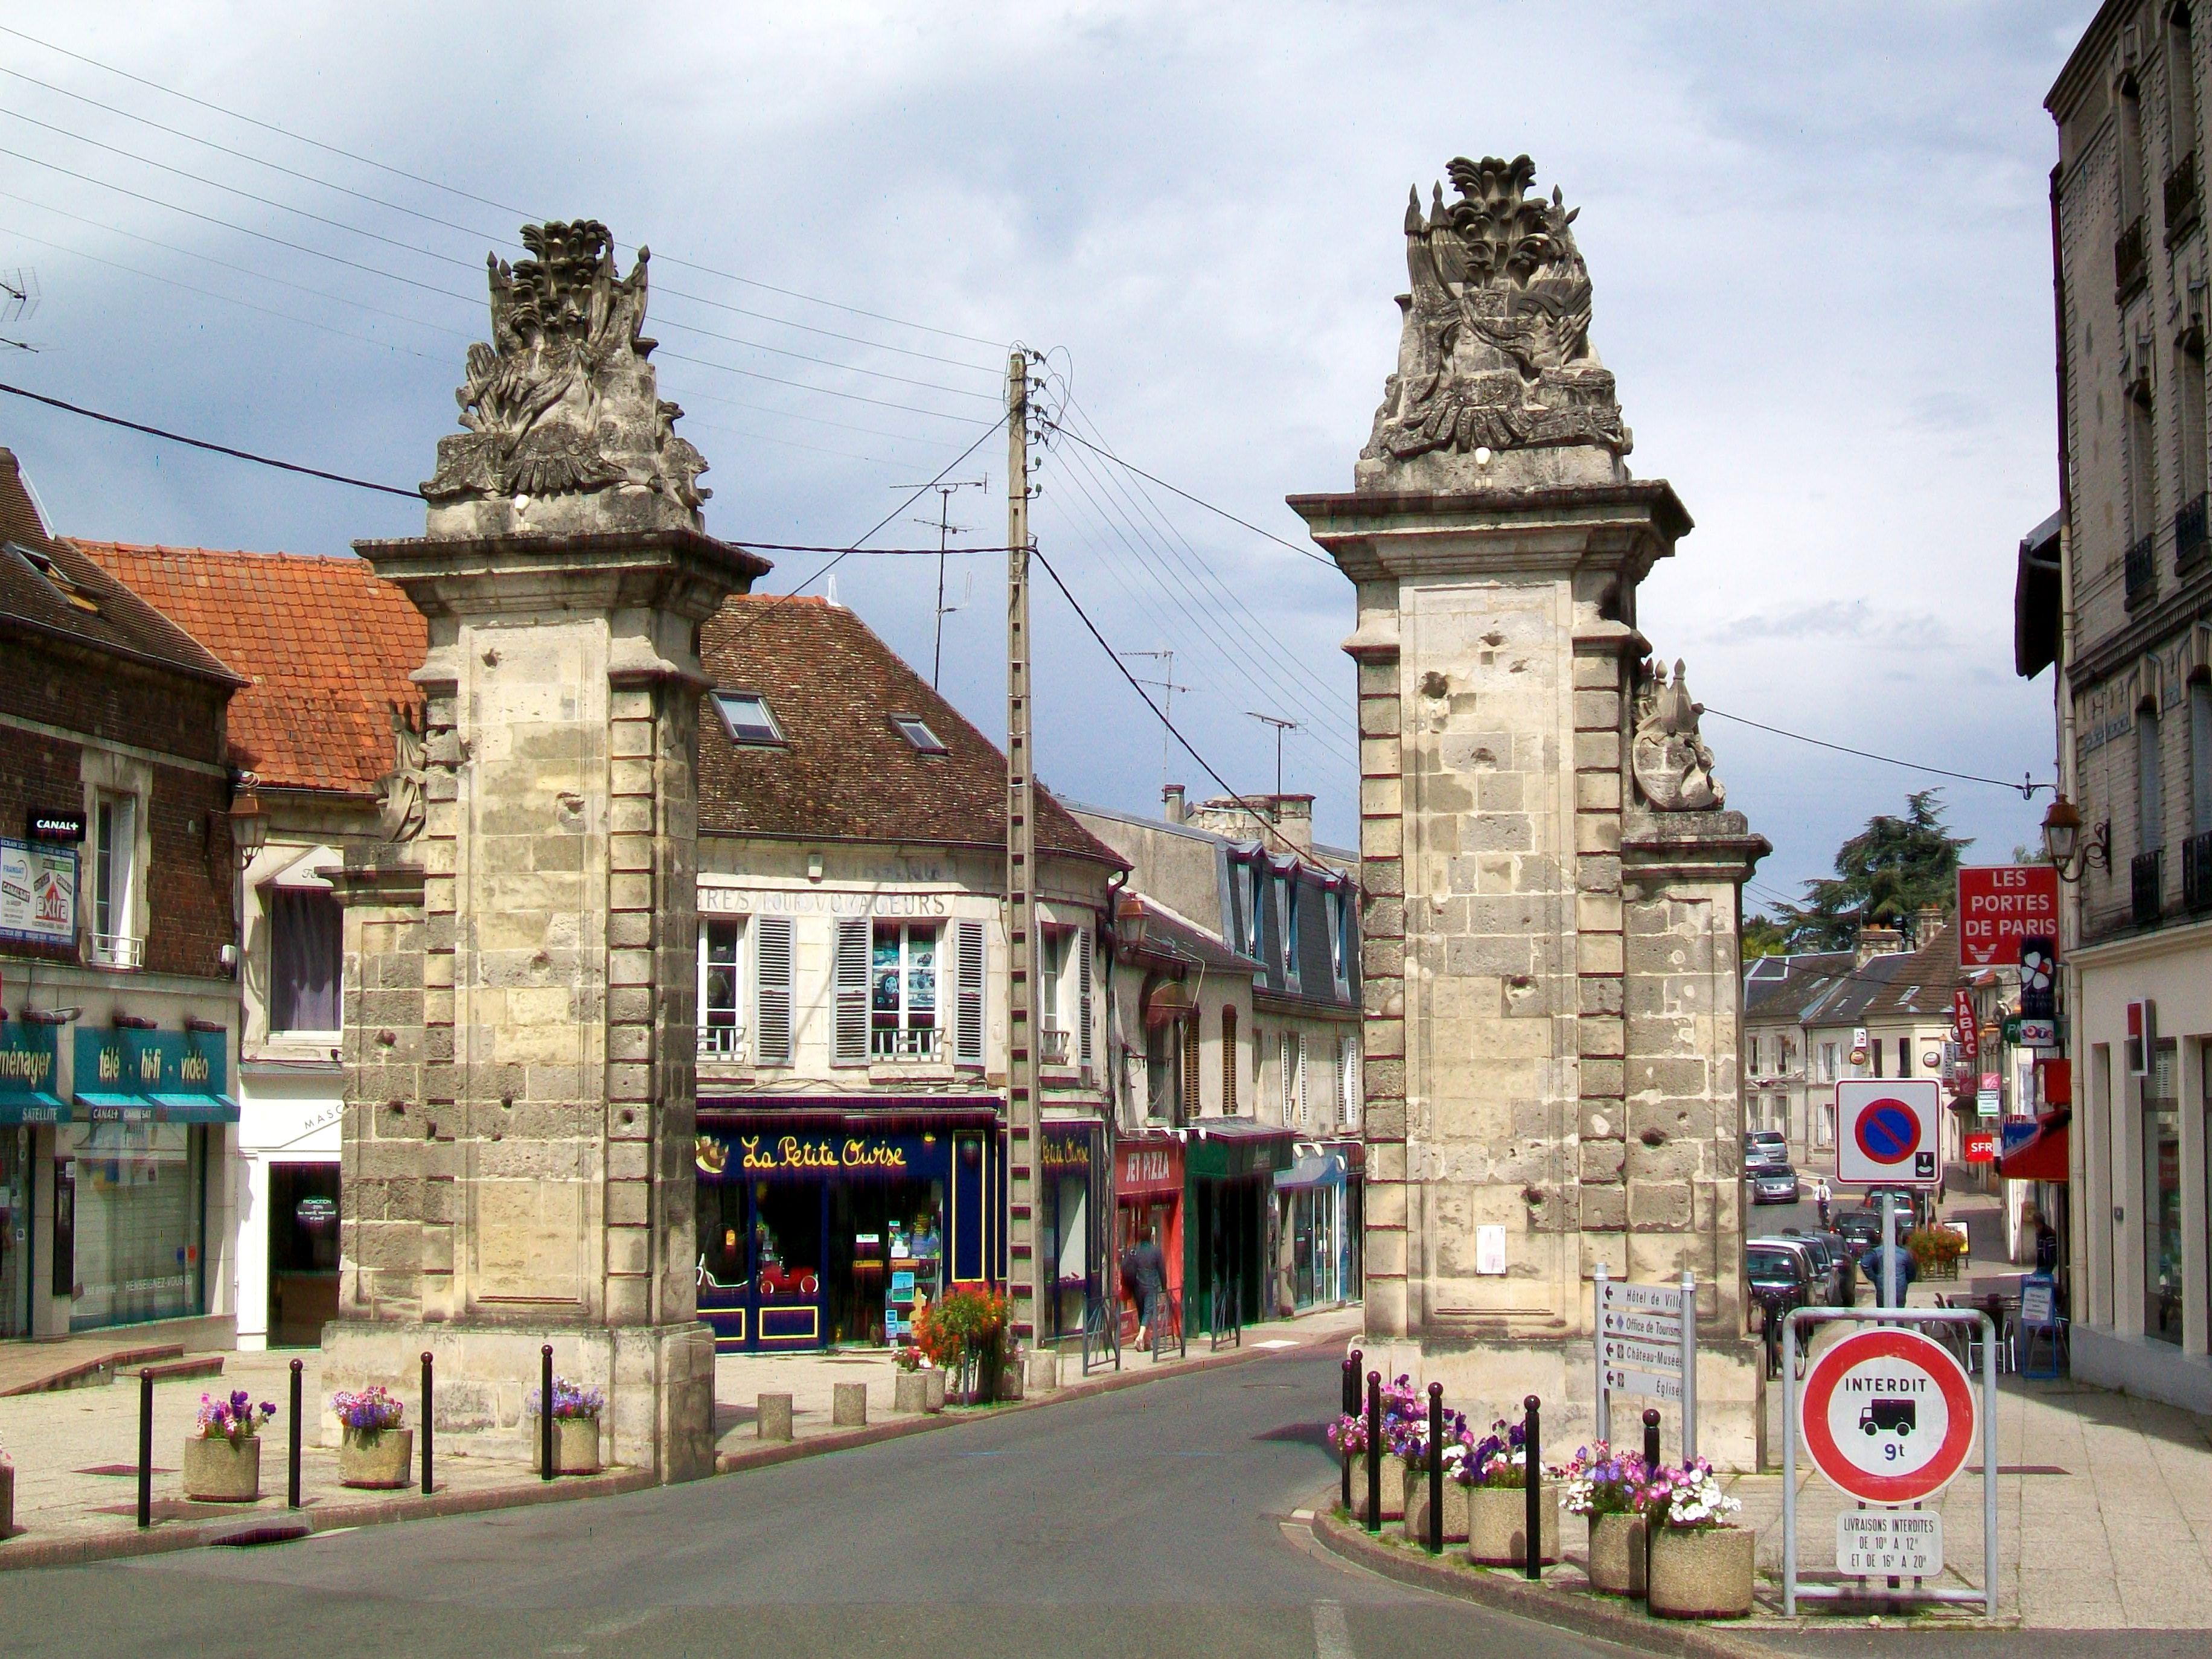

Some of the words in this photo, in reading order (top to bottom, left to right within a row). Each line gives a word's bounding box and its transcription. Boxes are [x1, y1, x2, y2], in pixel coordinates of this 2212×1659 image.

[36, 819, 78, 831] CANAL+
[1993, 870, 2027, 887] LES
[698, 889, 750, 912] RES
[1971, 894, 2050, 912] PORTES
[1966, 919, 1992, 936] DE
[1999, 918, 2056, 936] PARIS
[1956, 991, 1977, 1055] TABAC
[99, 1046, 120, 1079] télé
[181, 1050, 209, 1080] vidéo
[22, 1108, 58, 1122] SATELLITE
[92, 1108, 119, 1120] CANAL+
[741, 1135, 777, 1168] La
[778, 1136, 840, 1168] Petite
[842, 1139, 907, 1166] Ourse
[1971, 1142, 1993, 1152] SFR
[1126, 1152, 1140, 1182] JET
[1143, 1151, 1170, 1181] PIZZA
[1627, 1290, 1646, 1303] Hôtel
[1651, 1293, 1659, 1305] de
[1626, 1317, 1644, 1332] Office
[1646, 1321, 1653, 1333] de
[1656, 1322, 1681, 1338] Tourisme
[1627, 1346, 1682, 1367] Château-Musées
[1846, 1378, 1927, 1392] INTERDIT
[1844, 1518, 1887, 1532] LIVRAISONS
[1892, 1519, 1934, 1533] INTERDITES
[1859, 1536, 1868, 1549] DE
[1894, 1537, 1899, 1550] A
[1852, 1553, 1859, 1567] ET
[1867, 1554, 1875, 1567] DE
[1902, 1555, 1907, 1568] A
